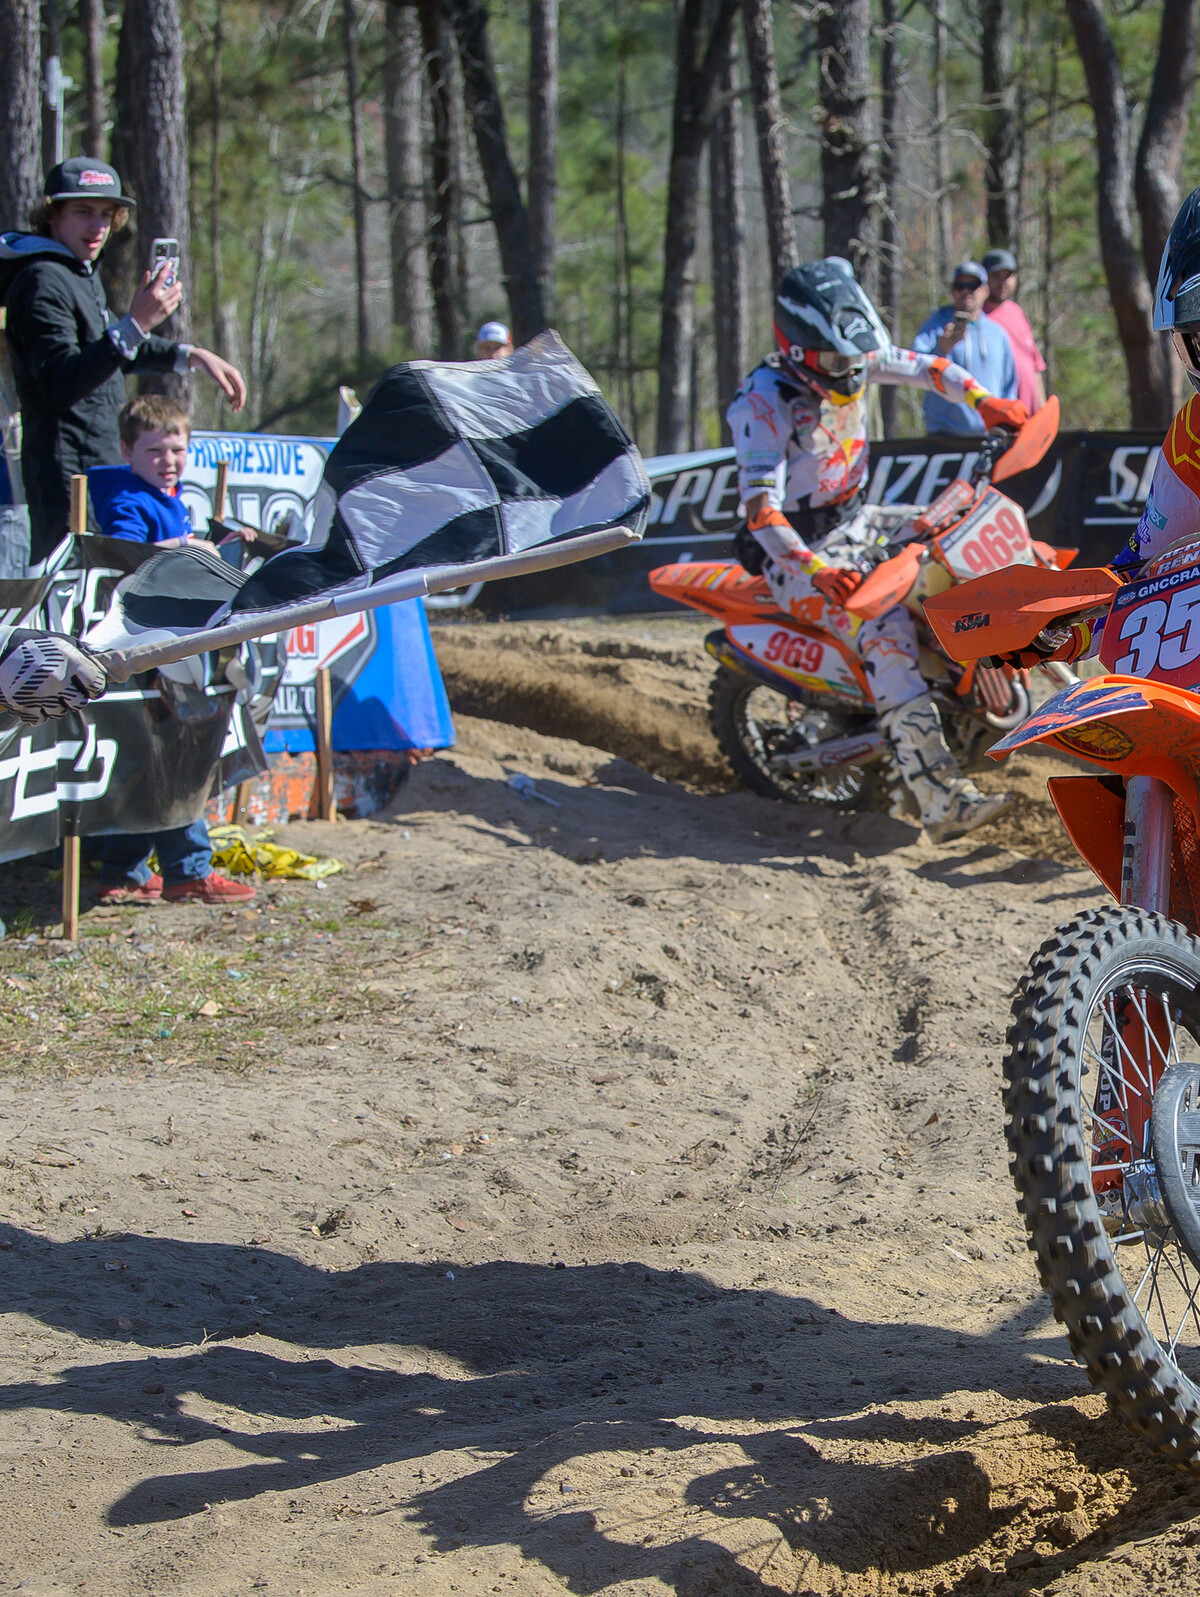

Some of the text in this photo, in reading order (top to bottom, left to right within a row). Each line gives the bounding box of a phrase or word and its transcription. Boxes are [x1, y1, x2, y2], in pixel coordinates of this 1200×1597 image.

[961, 508, 1028, 574] 969
[954, 612, 991, 634] KTM
[764, 631, 824, 673] 969
